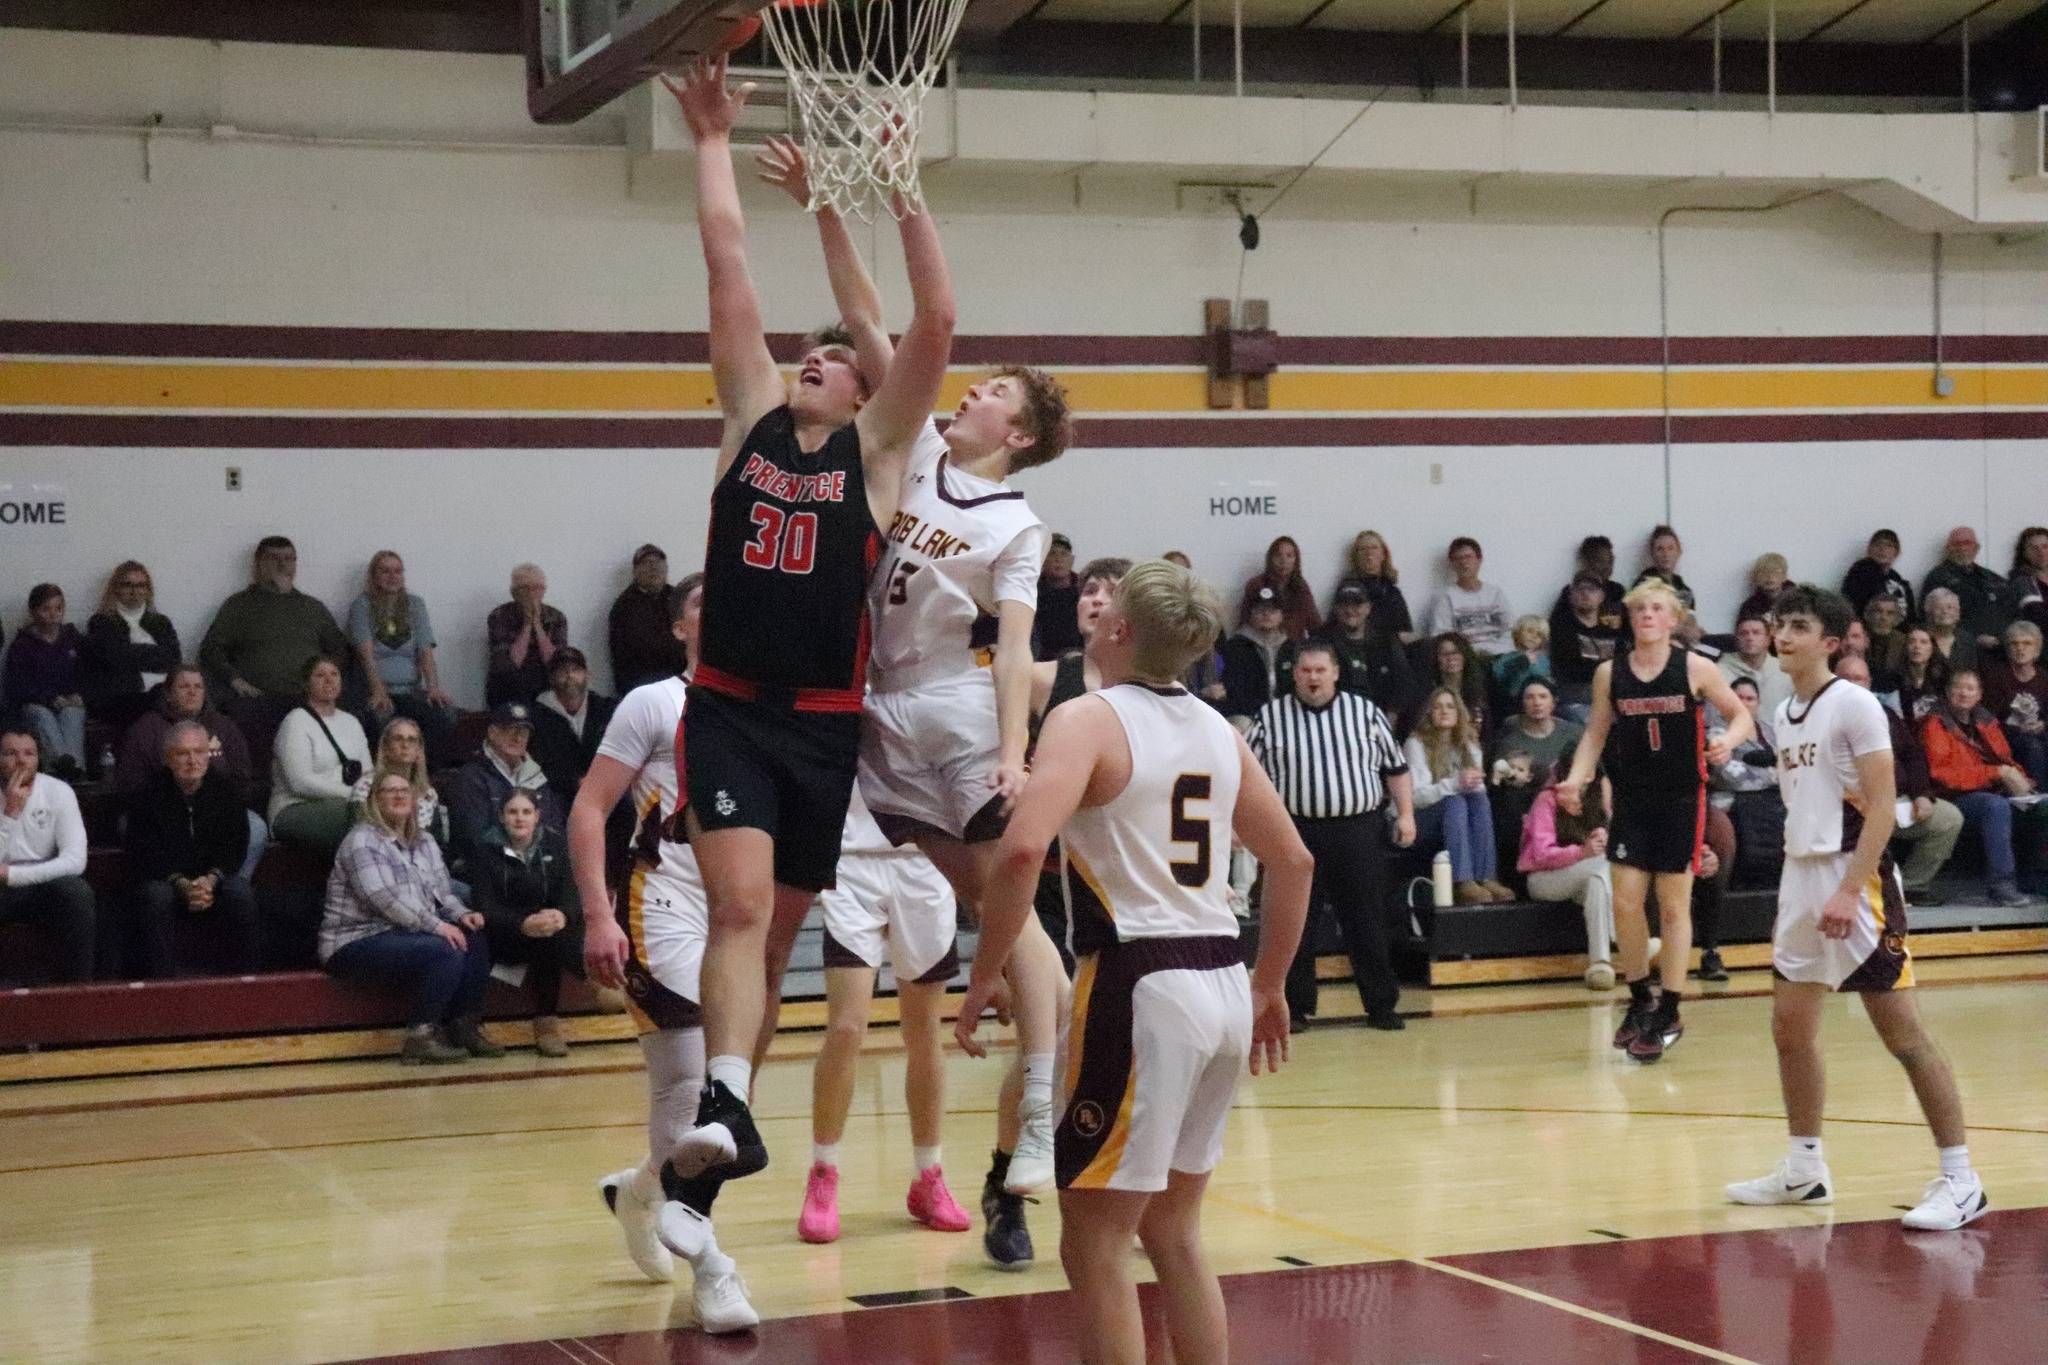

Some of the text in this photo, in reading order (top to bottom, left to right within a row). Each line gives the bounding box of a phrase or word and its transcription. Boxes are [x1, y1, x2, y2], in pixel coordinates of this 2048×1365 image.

[739, 452, 846, 503] PRENTCE
[1210, 496, 1278, 516] HOME
[743, 501, 818, 574] 30
[1647, 718, 1661, 751] 1
[1169, 772, 1212, 889] 5
